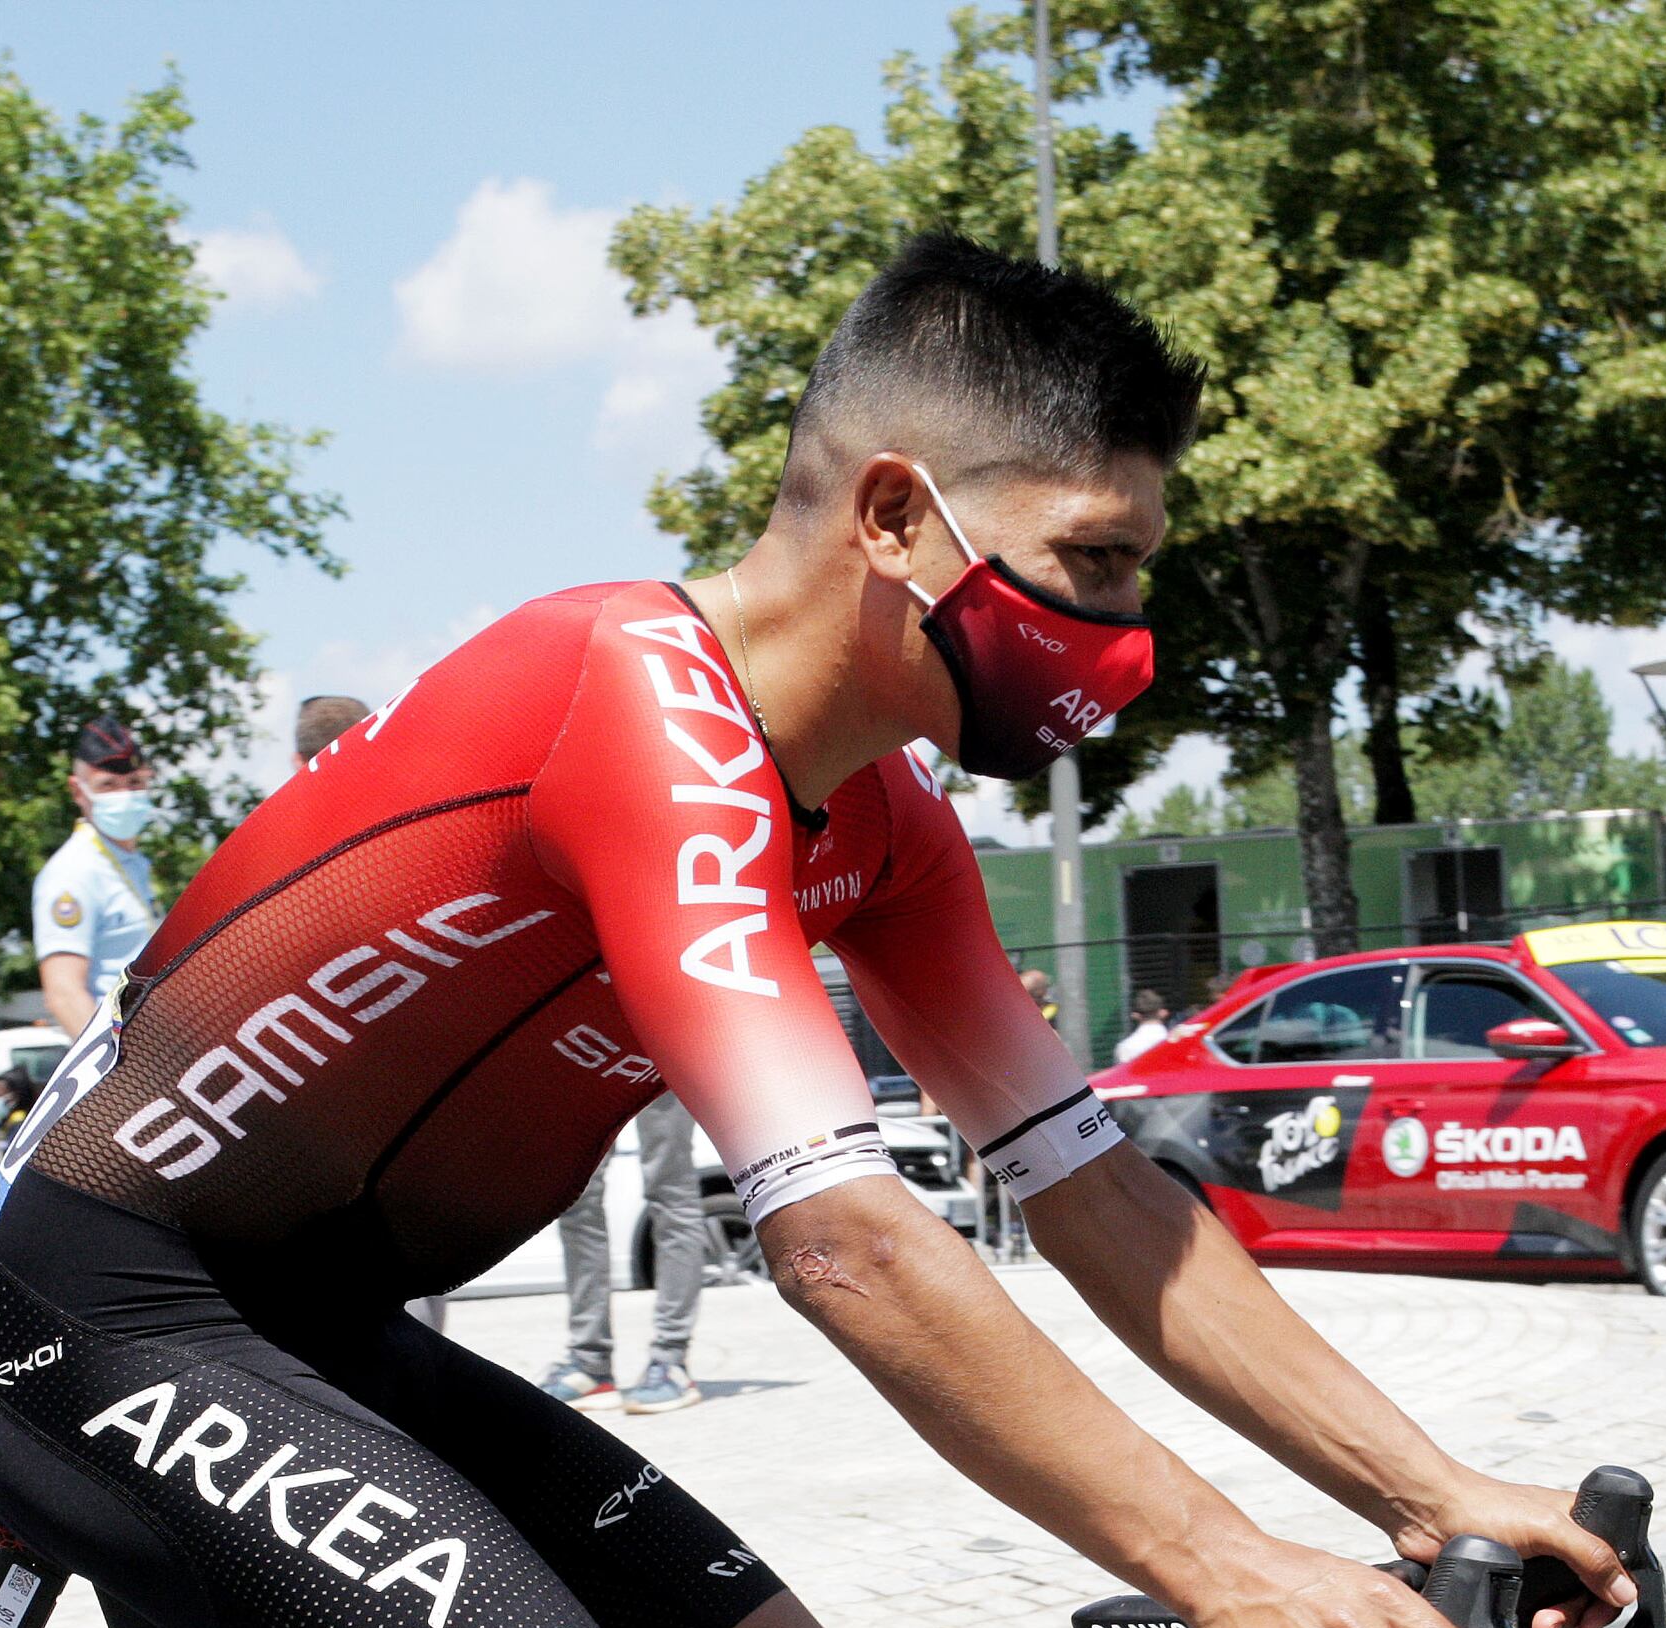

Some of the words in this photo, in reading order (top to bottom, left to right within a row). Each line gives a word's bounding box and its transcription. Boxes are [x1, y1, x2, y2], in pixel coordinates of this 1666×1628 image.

[1049, 688, 1111, 734] AR
[621, 613, 780, 999] ARKEA
[113, 892, 554, 1181] SAMSIC
[552, 1023, 661, 1084] SA
[1434, 1120, 1588, 1164] ŠKODA
